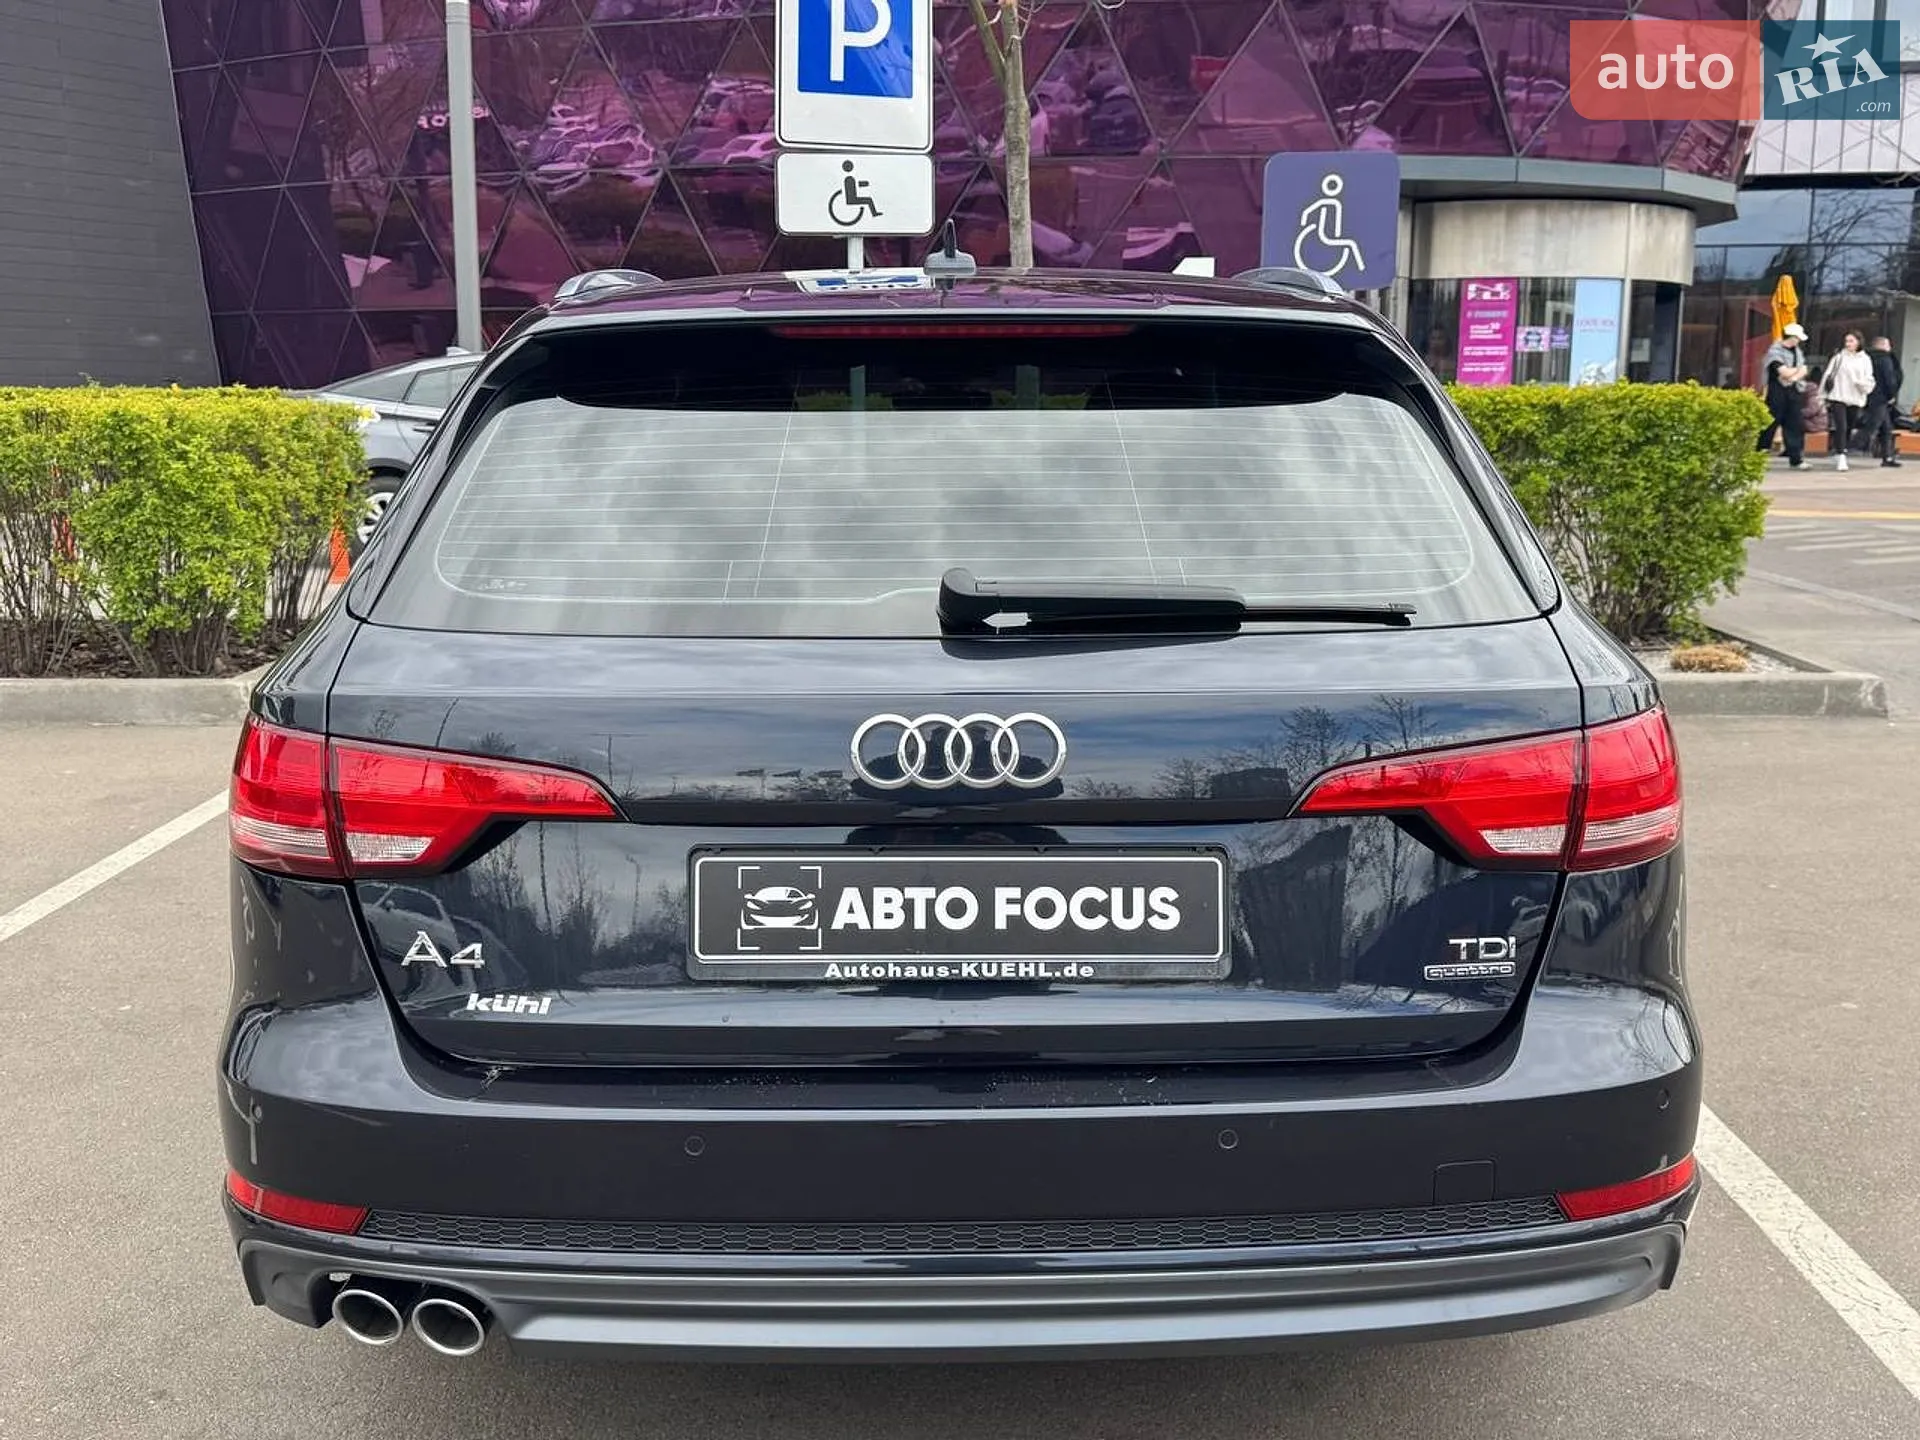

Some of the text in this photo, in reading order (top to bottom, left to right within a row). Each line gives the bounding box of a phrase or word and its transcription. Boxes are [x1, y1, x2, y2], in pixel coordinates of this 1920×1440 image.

[830, 0, 892, 82] P
[994, 886, 1181, 931] FOCUS
[401, 930, 485, 969] A4
[1449, 936, 1516, 960] TDI
[825, 962, 1094, 978] Autohaus-KUEHL.de
[1428, 965, 1512, 979] quattro
[466, 993, 552, 1015] kühl
